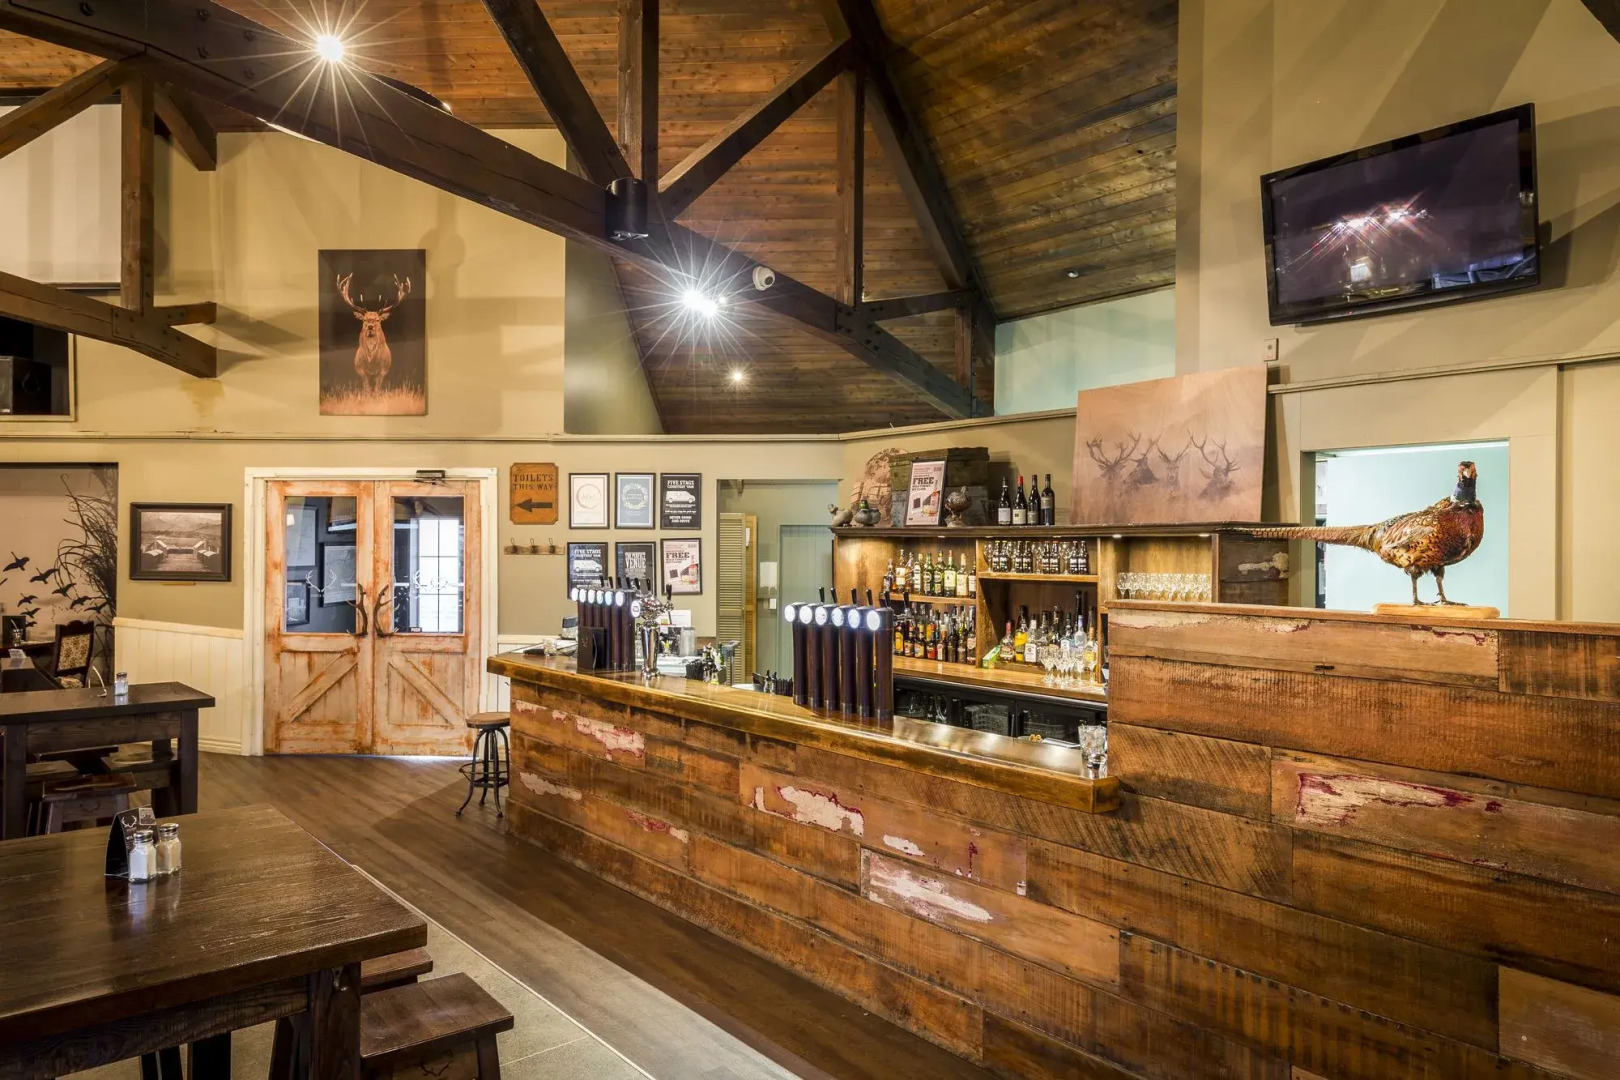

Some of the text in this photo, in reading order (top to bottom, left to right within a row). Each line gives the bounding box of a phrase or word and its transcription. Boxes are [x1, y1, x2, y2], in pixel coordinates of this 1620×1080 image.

[514, 474, 553, 482] TOILETS
[912, 477, 934, 485] FREE
[625, 556, 646, 568] VENUE
